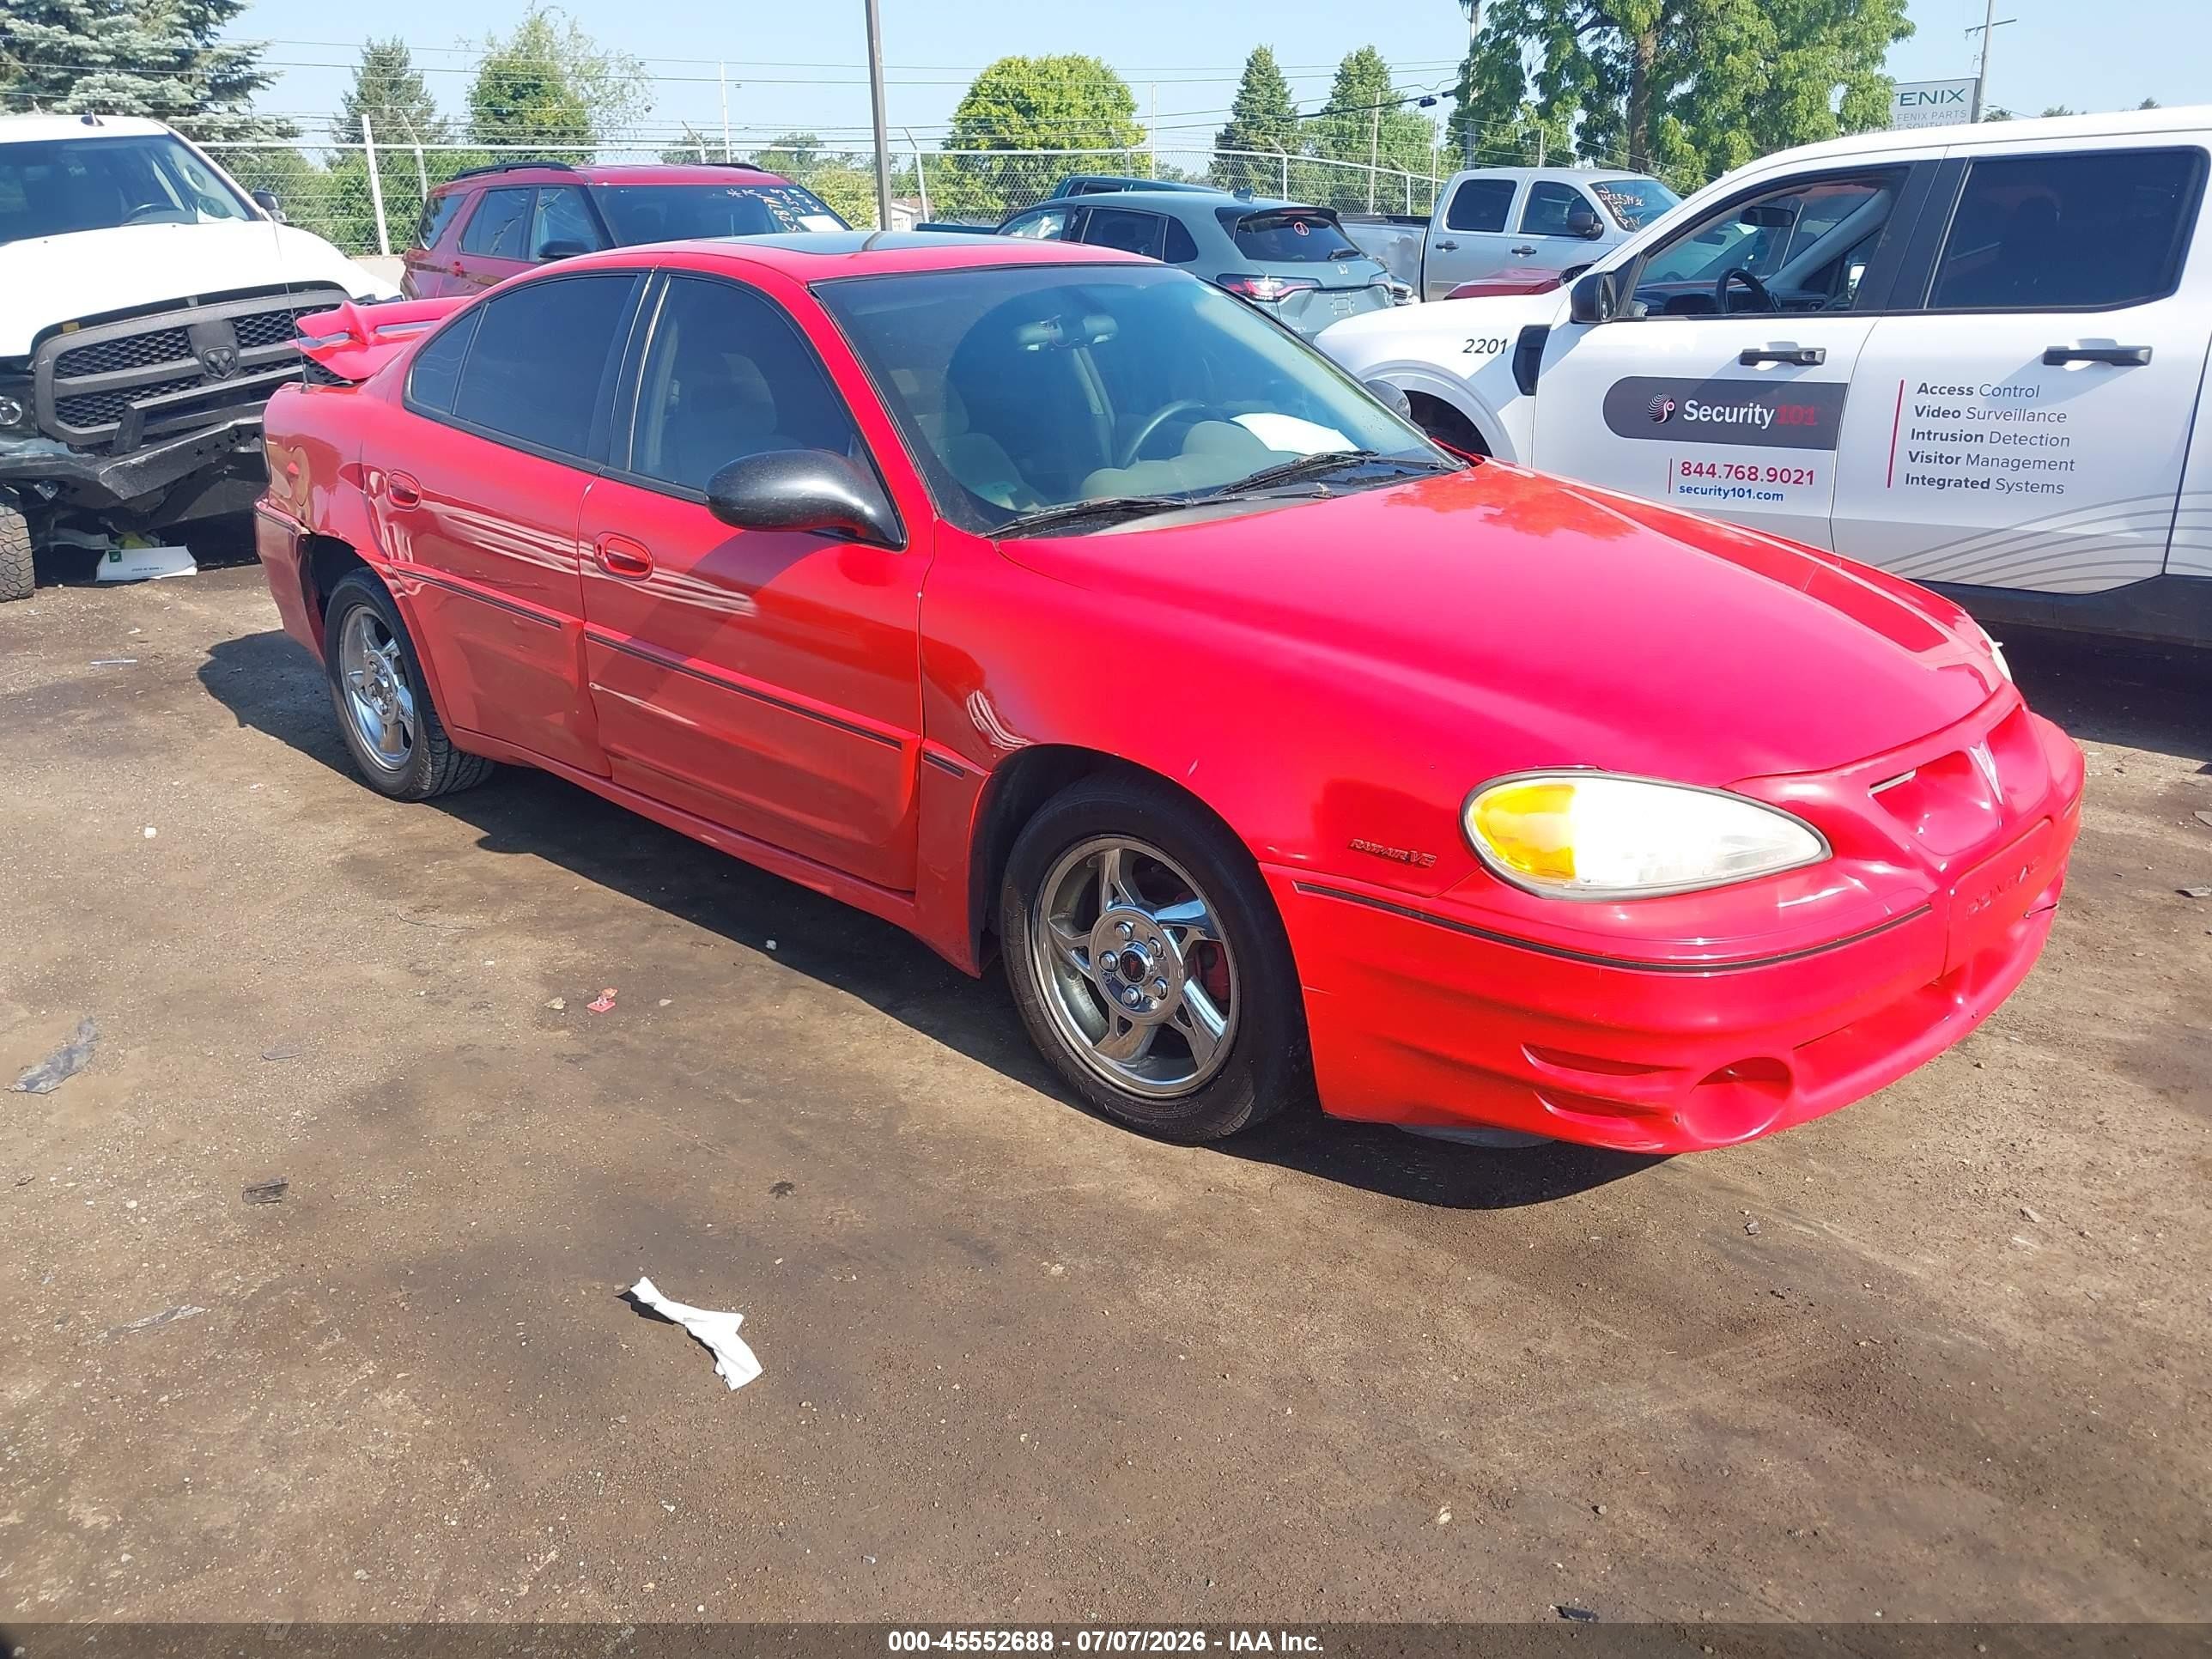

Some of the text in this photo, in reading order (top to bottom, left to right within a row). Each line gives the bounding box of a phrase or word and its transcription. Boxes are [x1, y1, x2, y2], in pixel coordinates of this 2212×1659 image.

[1895, 88, 1966, 106] ENIX
[1897, 109, 1966, 121] FENIX PARTS
[1462, 338, 1508, 355] 2201
[1917, 382, 2040, 398] Access Control
[1914, 405, 2068, 423] Video Surveillance
[1910, 428, 2070, 447] Intrusion Detection
[1908, 450, 2075, 472] Visitor Management
[1680, 461, 1814, 486] 844.768.9021
[1679, 483, 1784, 502] security101.com
[1905, 473, 2065, 495] Integrated Systems
